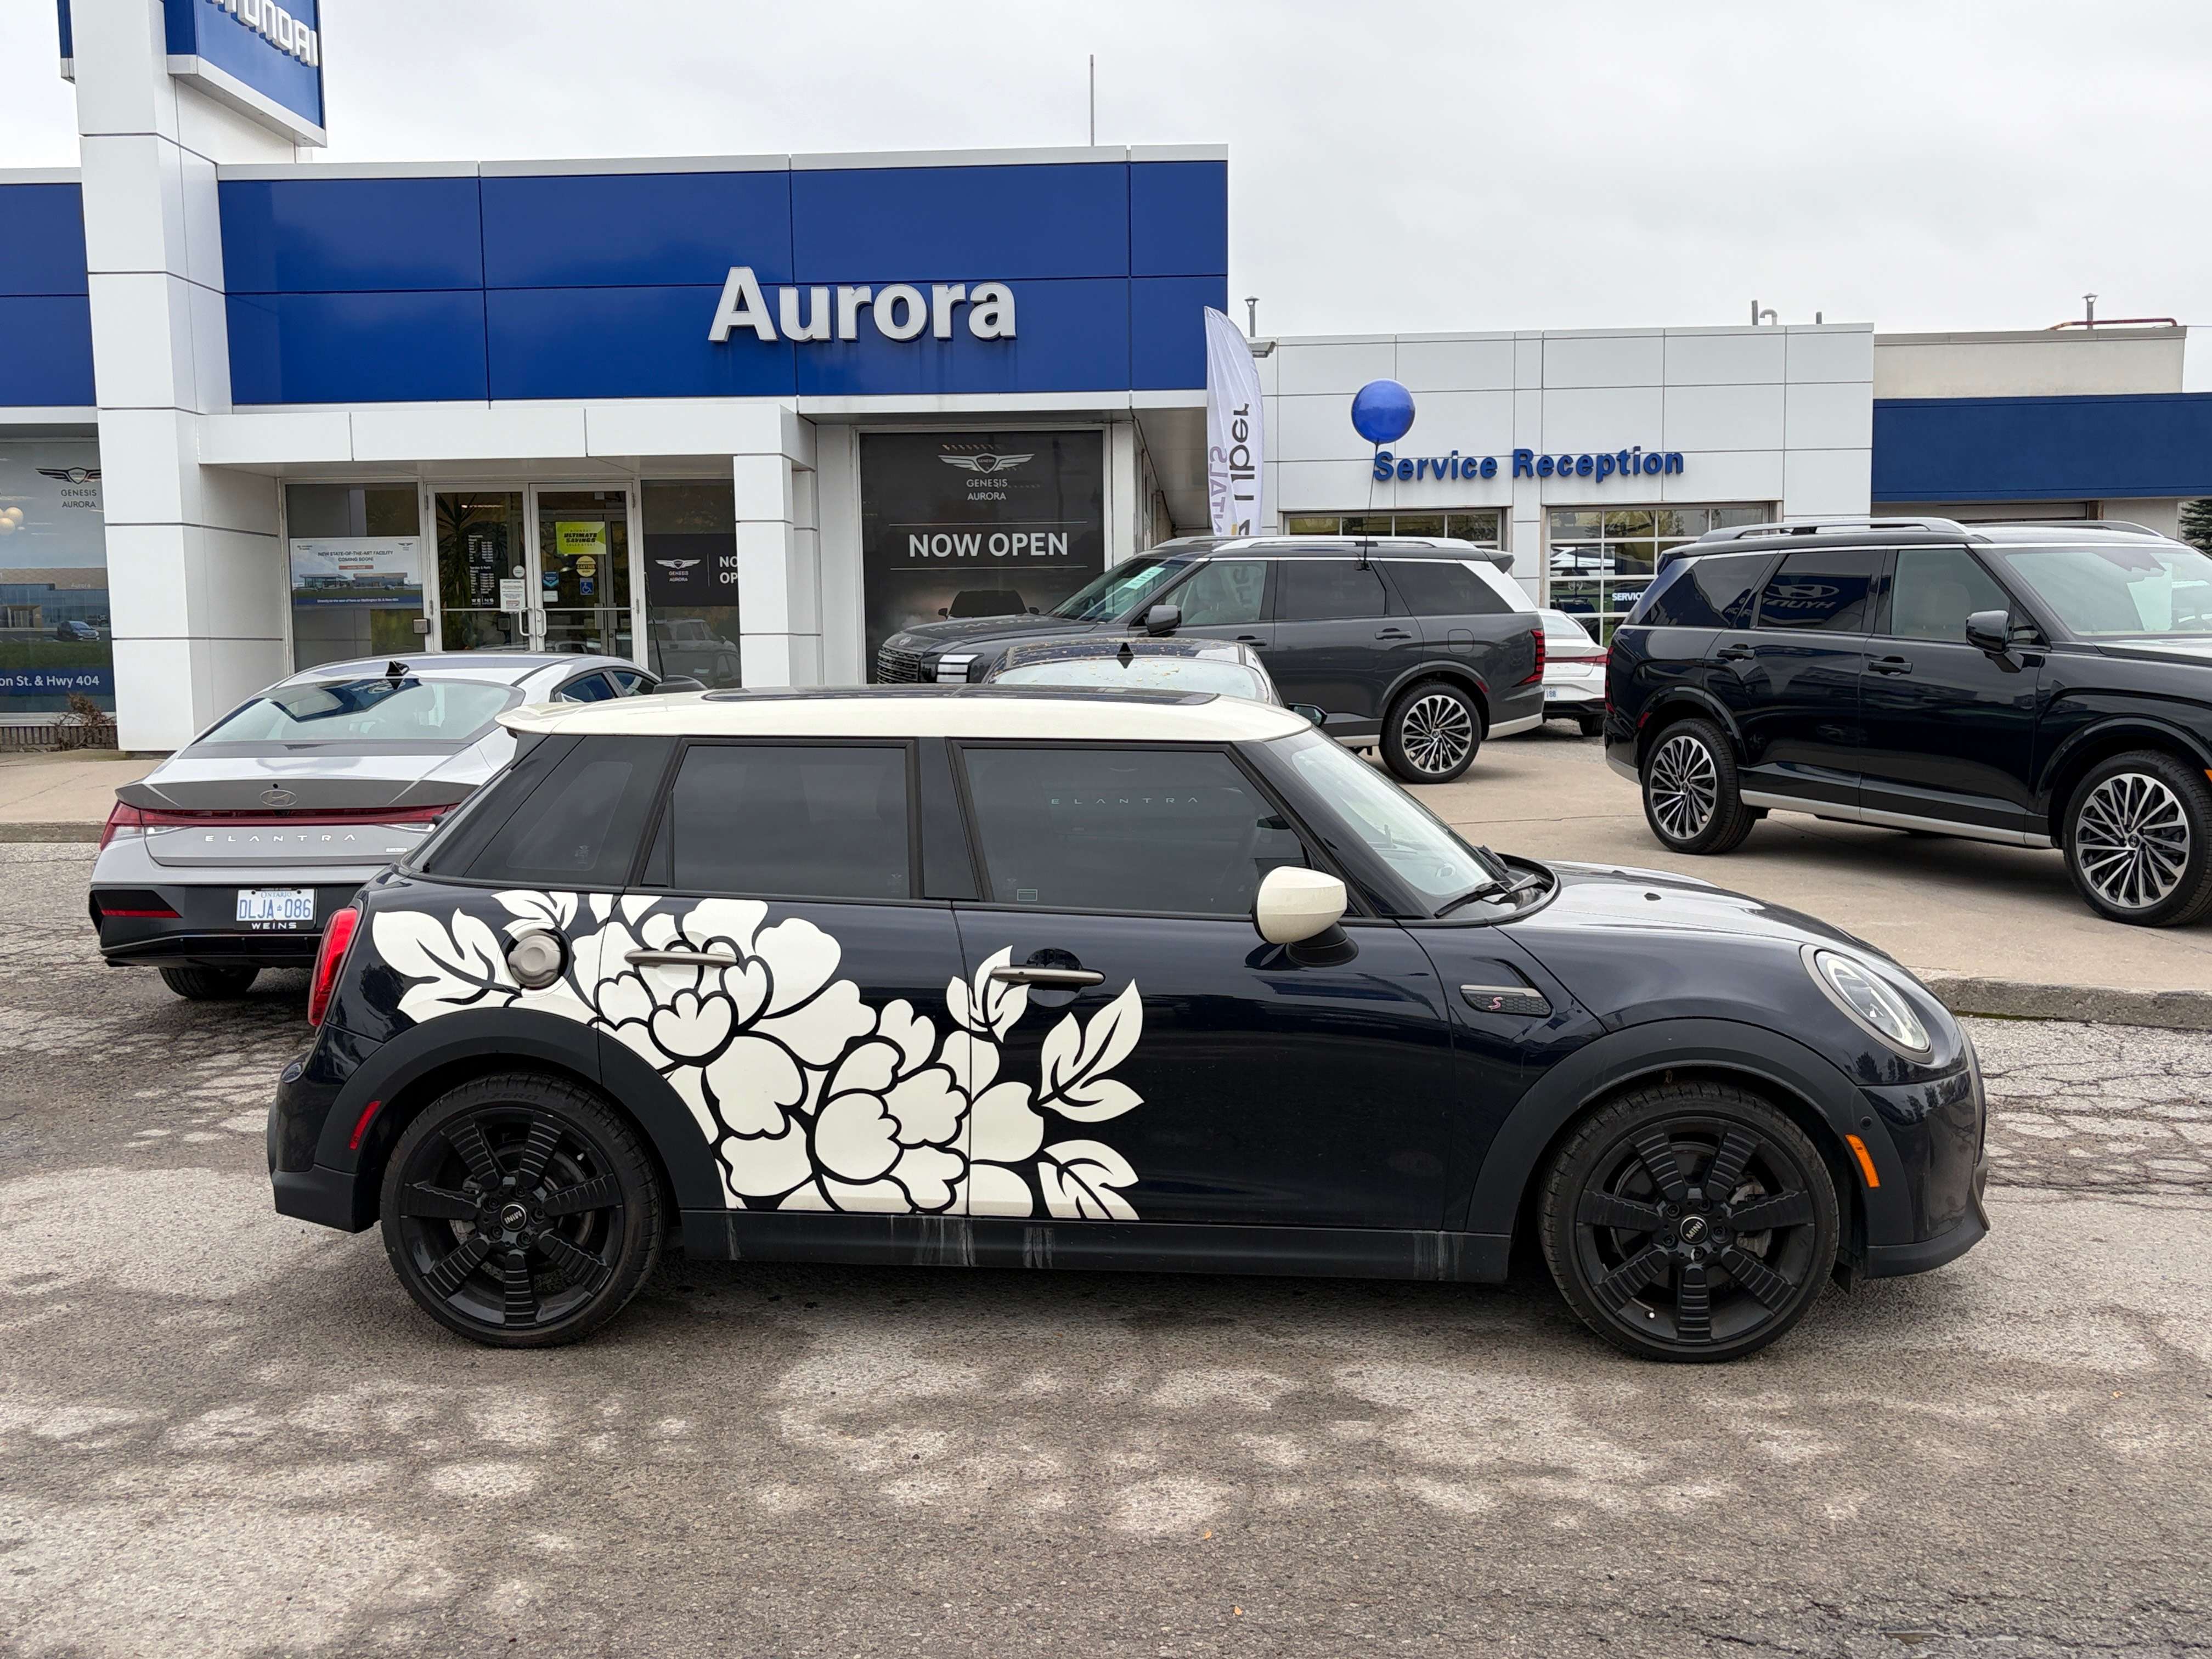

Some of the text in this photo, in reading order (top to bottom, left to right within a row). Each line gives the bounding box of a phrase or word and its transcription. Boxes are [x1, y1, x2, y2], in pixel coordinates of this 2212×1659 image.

[213, 0, 319, 67] UNDAI
[707, 266, 1017, 342] Aurora
[1374, 446, 1684, 483] Service Reception
[966, 478, 1008, 487] GENESIS
[967, 492, 1007, 500] AURORA
[909, 532, 1068, 558] NOW OPEN
[719, 556, 738, 568] NO
[719, 572, 738, 584] OP
[1612, 592, 1645, 601] SERVIC
[16, 675, 32, 686] St.
[34, 675, 44, 686] &
[46, 675, 74, 688] Hwy
[76, 675, 100, 686] 404
[205, 834, 356, 842] ELANTRA
[239, 898, 311, 919] DLJA 086
[251, 922, 297, 930] WEINS
[1487, 996, 1504, 1011] S
[503, 1210, 523, 1224] MINI
[1685, 1221, 1703, 1240] MINI
